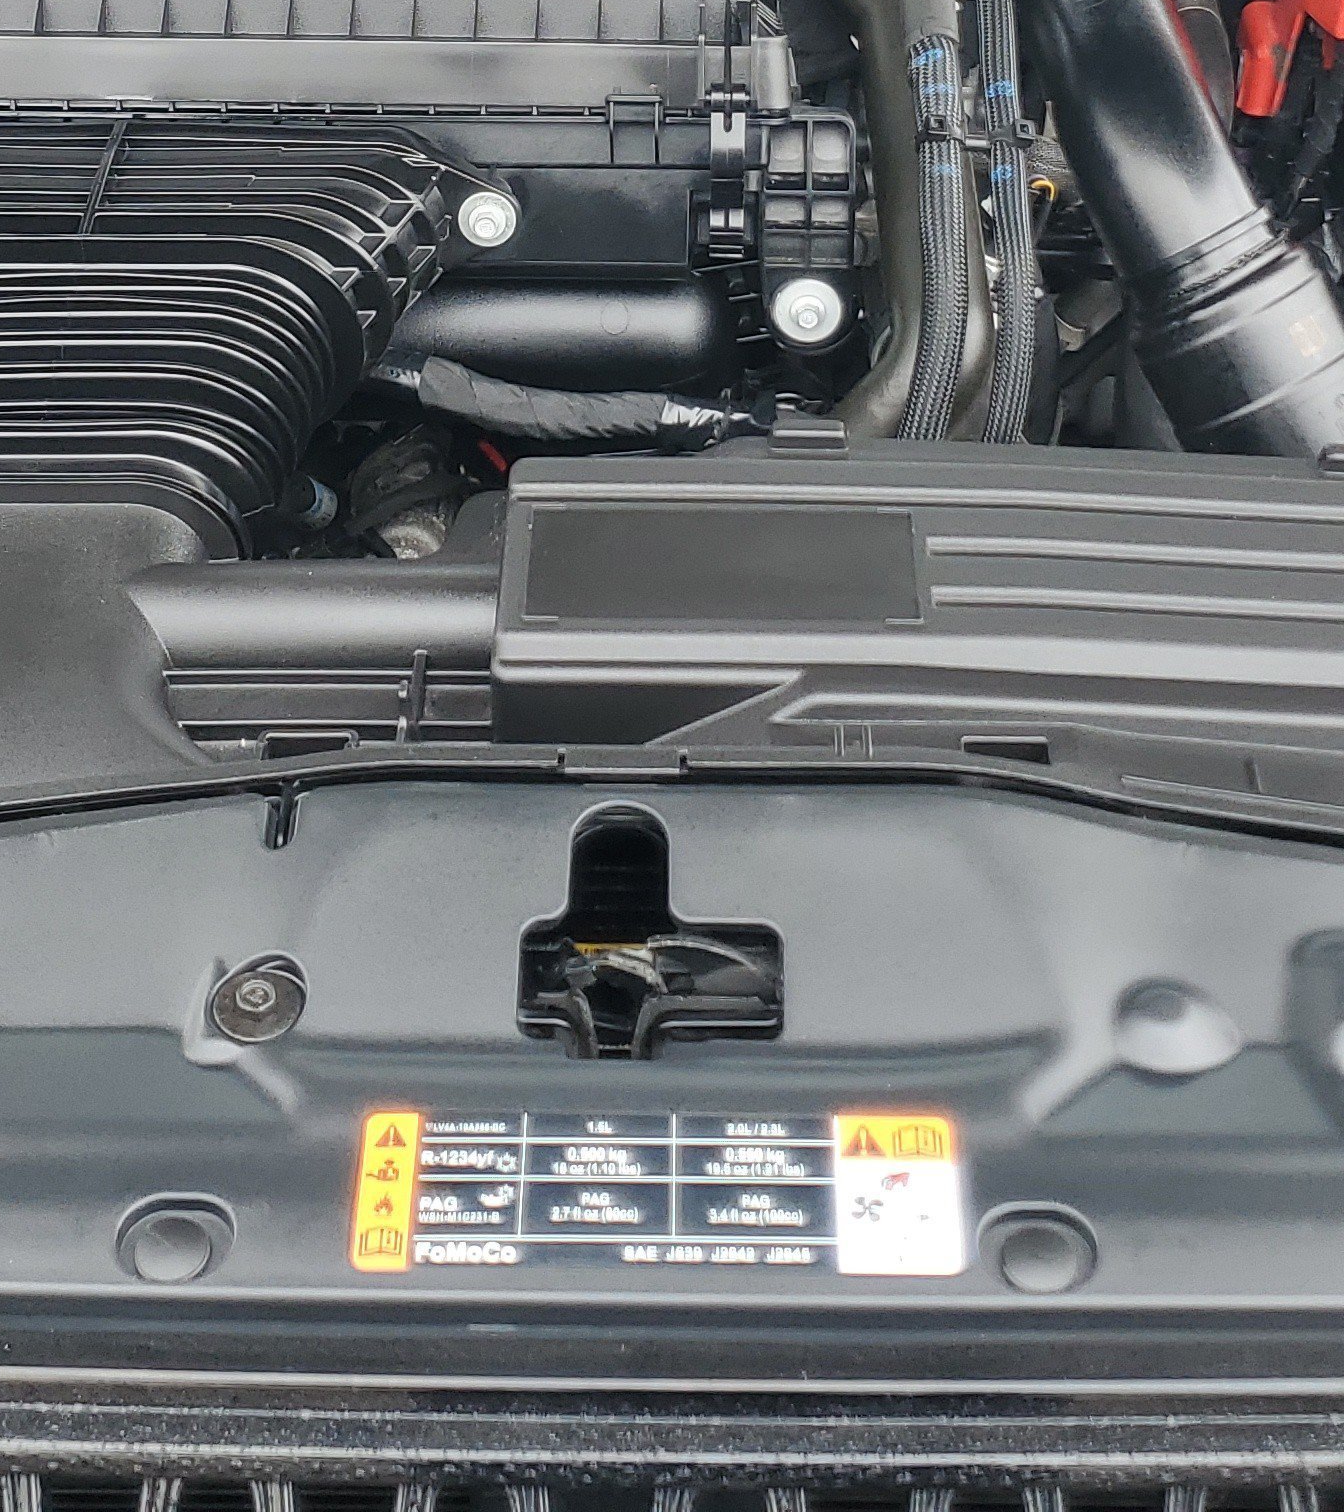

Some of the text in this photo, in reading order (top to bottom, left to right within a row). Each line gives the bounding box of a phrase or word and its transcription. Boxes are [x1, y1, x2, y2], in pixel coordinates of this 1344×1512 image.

[420, 1150, 494, 1169] R-1234yf
[608, 1146, 628, 1165] kg
[766, 1147, 785, 1166] kg
[419, 1196, 458, 1212] PAG
[581, 1192, 611, 1206] PAG
[741, 1194, 771, 1208] PAG
[415, 1241, 518, 1264] FoMoCo
[624, 1245, 658, 1261] SAE
